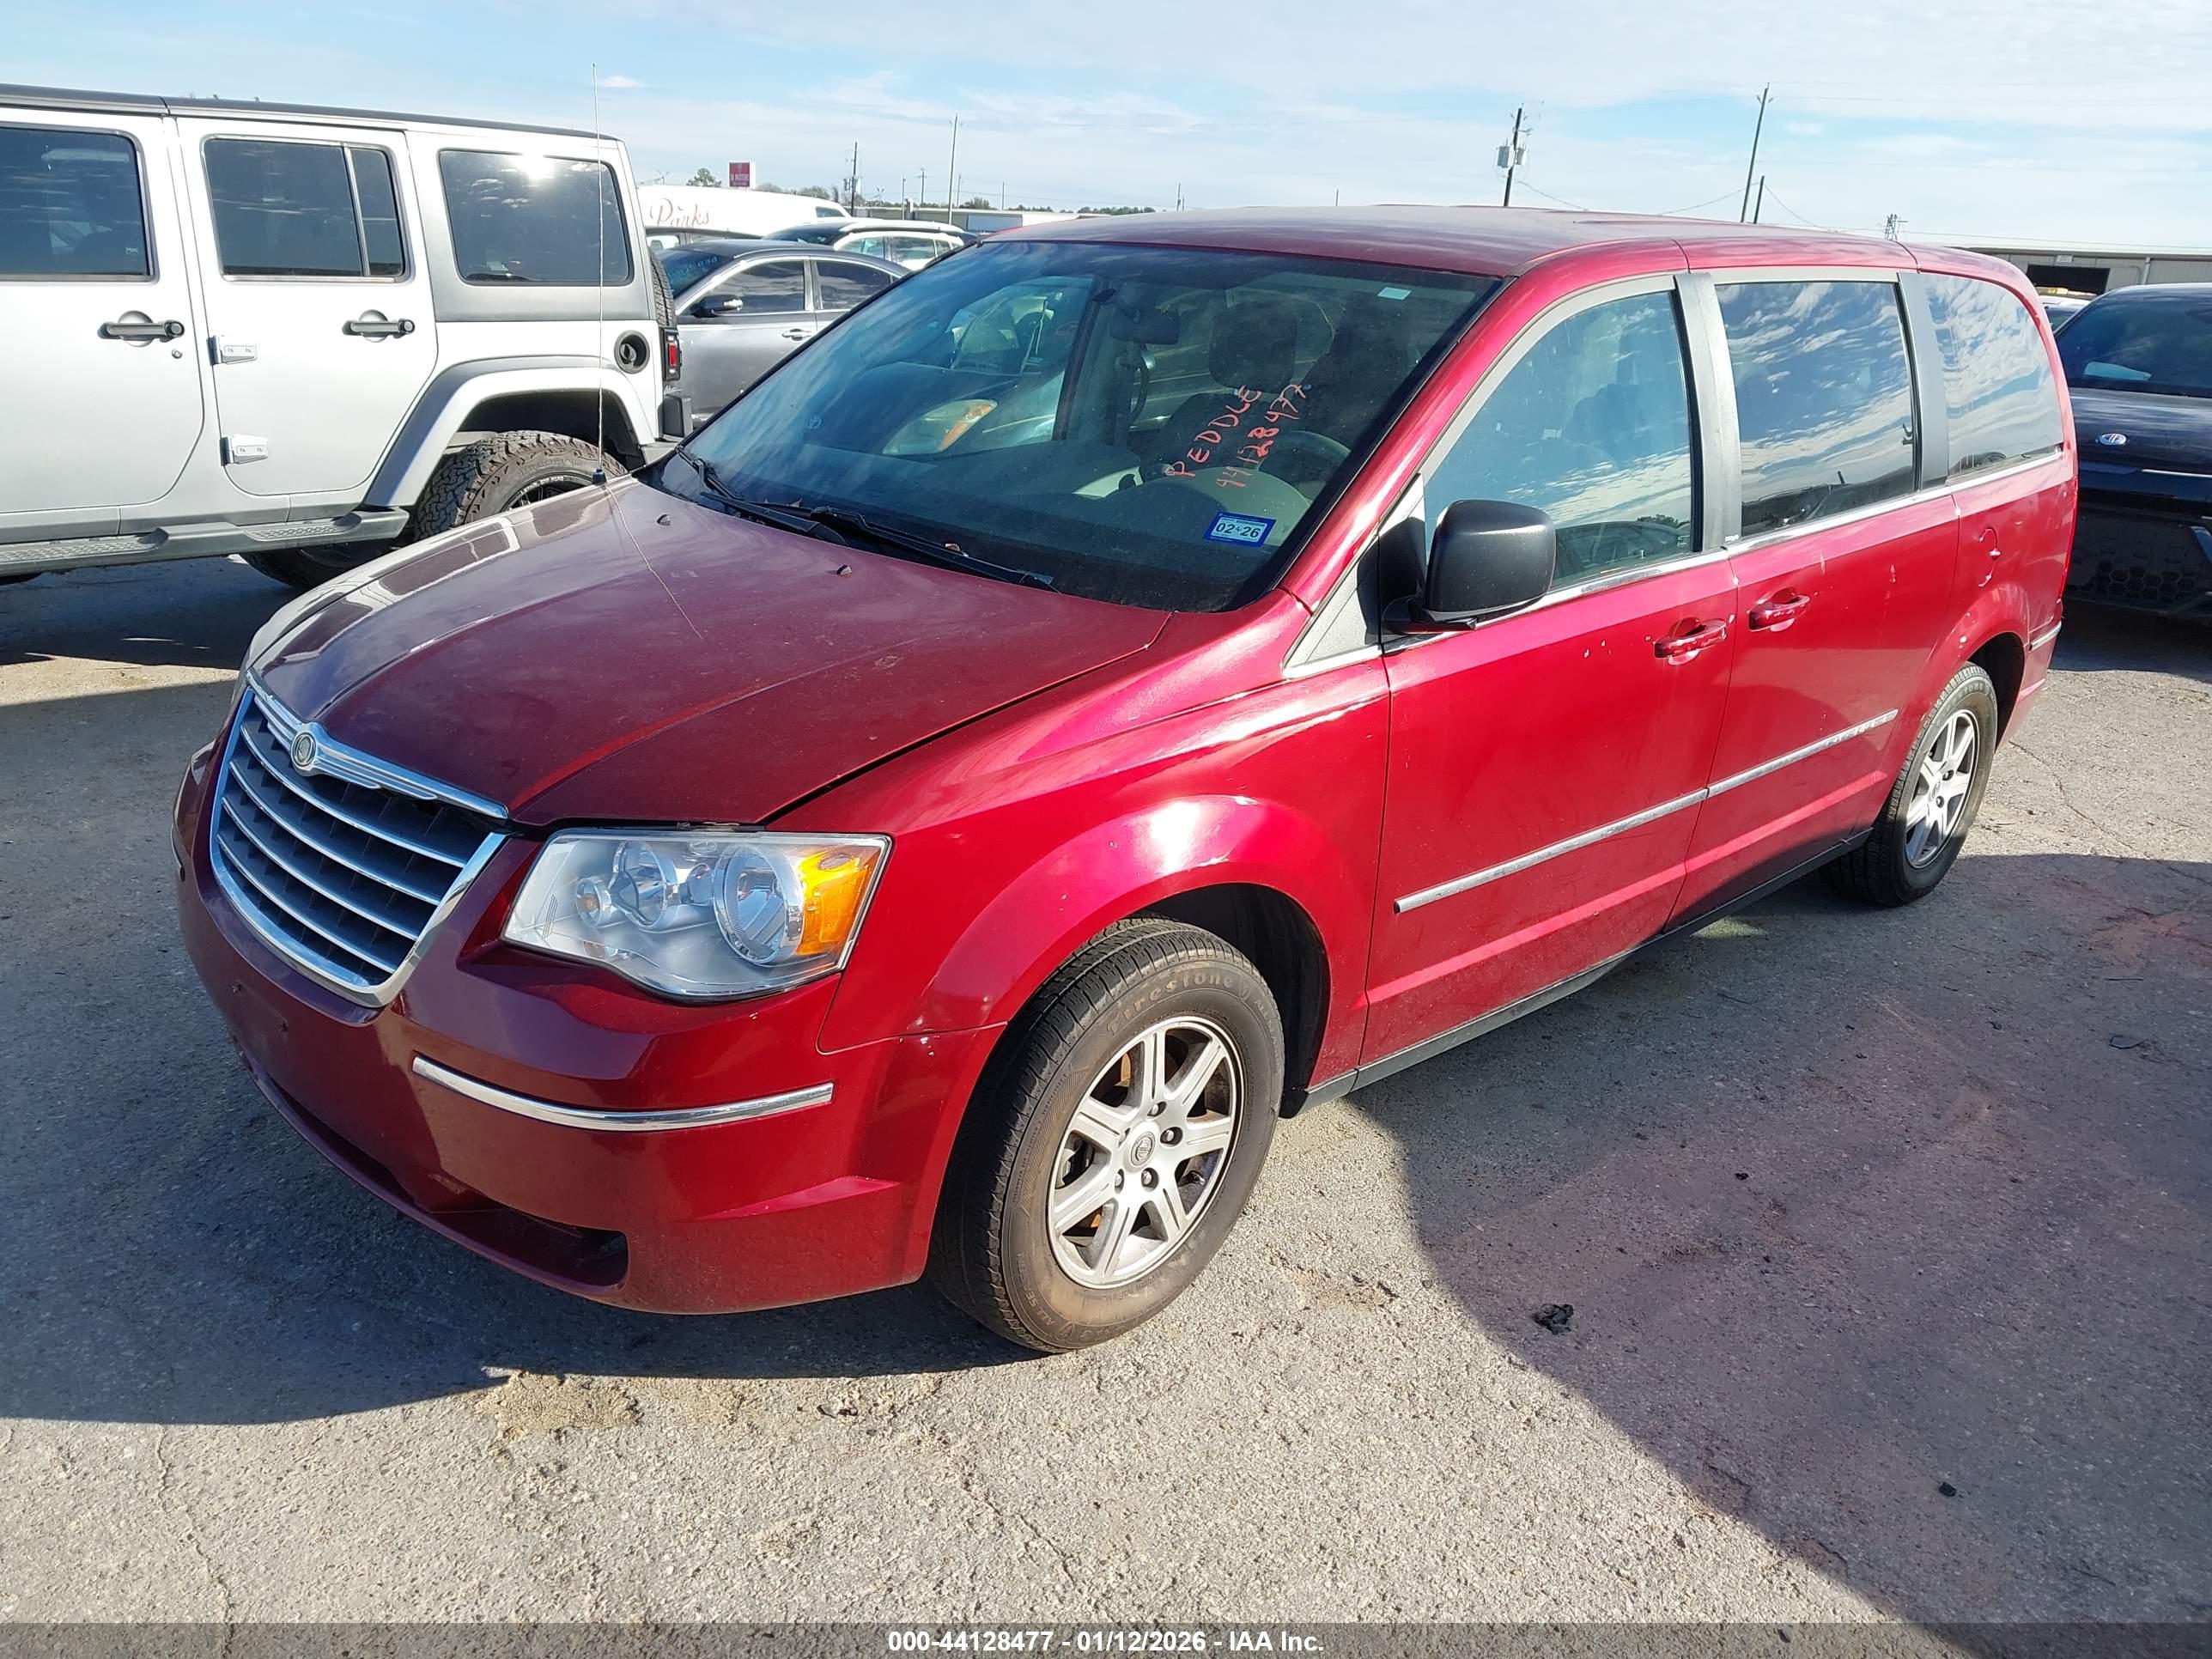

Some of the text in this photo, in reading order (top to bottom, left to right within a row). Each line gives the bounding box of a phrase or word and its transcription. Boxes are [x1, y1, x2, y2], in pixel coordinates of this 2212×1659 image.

[1164, 385, 1262, 477] PEDDLE
[1216, 384, 1306, 488] 44128477
[1215, 522, 1236, 534] 02
[1240, 526, 1261, 538] 26
[1106, 971, 1235, 1036] Firestone
